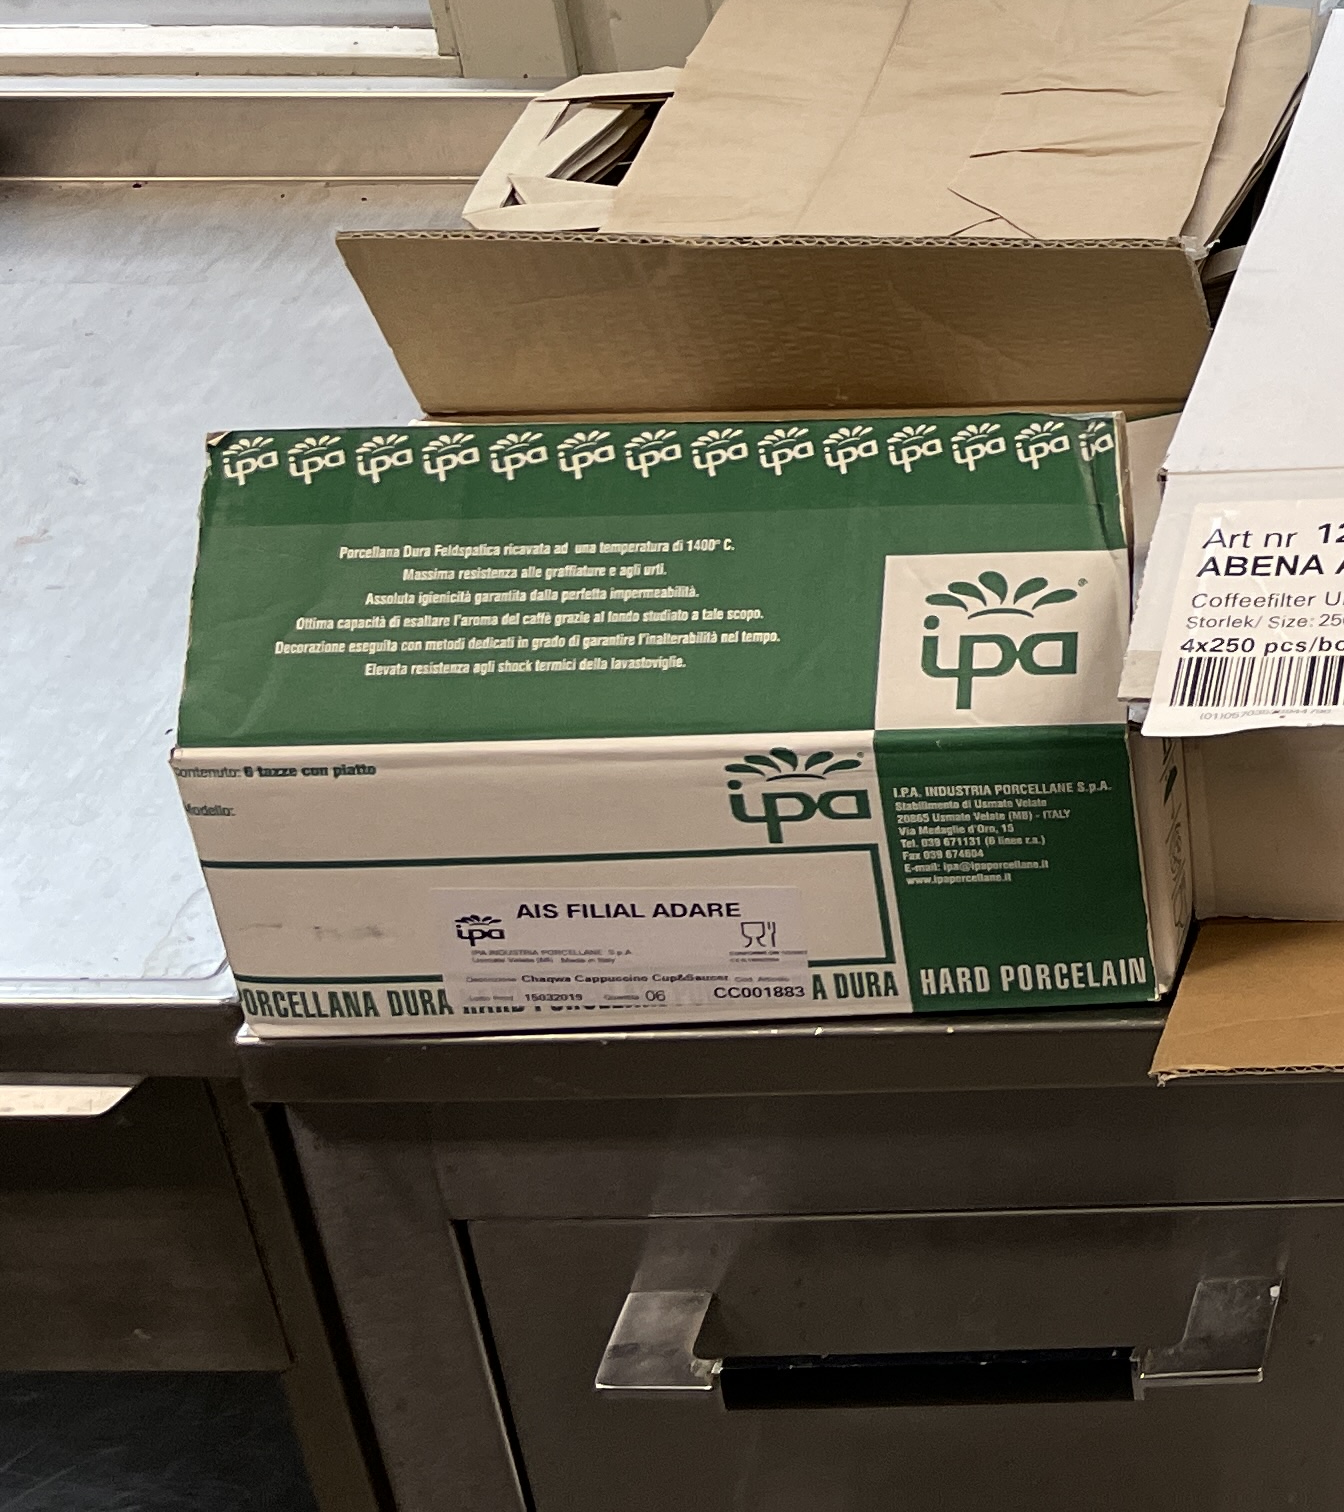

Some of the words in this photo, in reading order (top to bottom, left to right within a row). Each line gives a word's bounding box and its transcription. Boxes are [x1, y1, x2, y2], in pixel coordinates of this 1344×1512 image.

[222, 450, 279, 486] ipa
[288, 449, 346, 485] ipa
[355, 448, 413, 484] ipa
[421, 447, 481, 483] ipa
[489, 446, 548, 481] ipa
[558, 444, 616, 480] ipa
[625, 443, 682, 478] ipa
[692, 441, 749, 477] ipa
[758, 439, 815, 477] ipa
[823, 438, 879, 475] ipa
[888, 438, 943, 474] ipa
[952, 436, 1006, 472] ipa
[1016, 435, 1070, 471] ipa
[1202, 527, 1252, 549] Art
[1263, 530, 1298, 549] nr
[339, 545, 400, 560] Porcellana
[403, 545, 431, 558] Dura
[503, 543, 551, 556] ricavata
[553, 542, 568, 554] ad
[575, 543, 597, 554] una
[599, 540, 669, 555] temperatura
[672, 540, 684, 552] di
[1195, 553, 1324, 578] ABENA
[1191, 592, 1316, 610] Coffeefilter
[1185, 614, 1262, 630] Storlek/
[1267, 614, 1315, 629] Size:
[1179, 637, 1255, 654] 4x250
[365, 662, 408, 676] Elevata
[410, 661, 470, 675] resistenza
[473, 661, 495, 675] agli
[497, 660, 532, 672] shock
[579, 657, 608, 670] della
[921, 615, 1079, 710] ipa
[925, 785, 992, 797] INDUSTRIA
[994, 783, 1074, 795] PORCELLANE
[1076, 780, 1113, 794] S.p.A.
[727, 779, 872, 844] ipa
[516, 904, 559, 920] AIS
[567, 903, 646, 919] FILIAL
[651, 903, 742, 918] ADARE
[455, 924, 505, 946] ipa
[919, 966, 991, 996] HARD
[1000, 957, 1147, 992] PORCELAIN
[238, 989, 381, 1019] ORCELLANA
[387, 988, 455, 1016] DURA
[833, 970, 900, 999] DURA
[645, 990, 666, 1002] 06
[713, 986, 806, 999] CC001883
